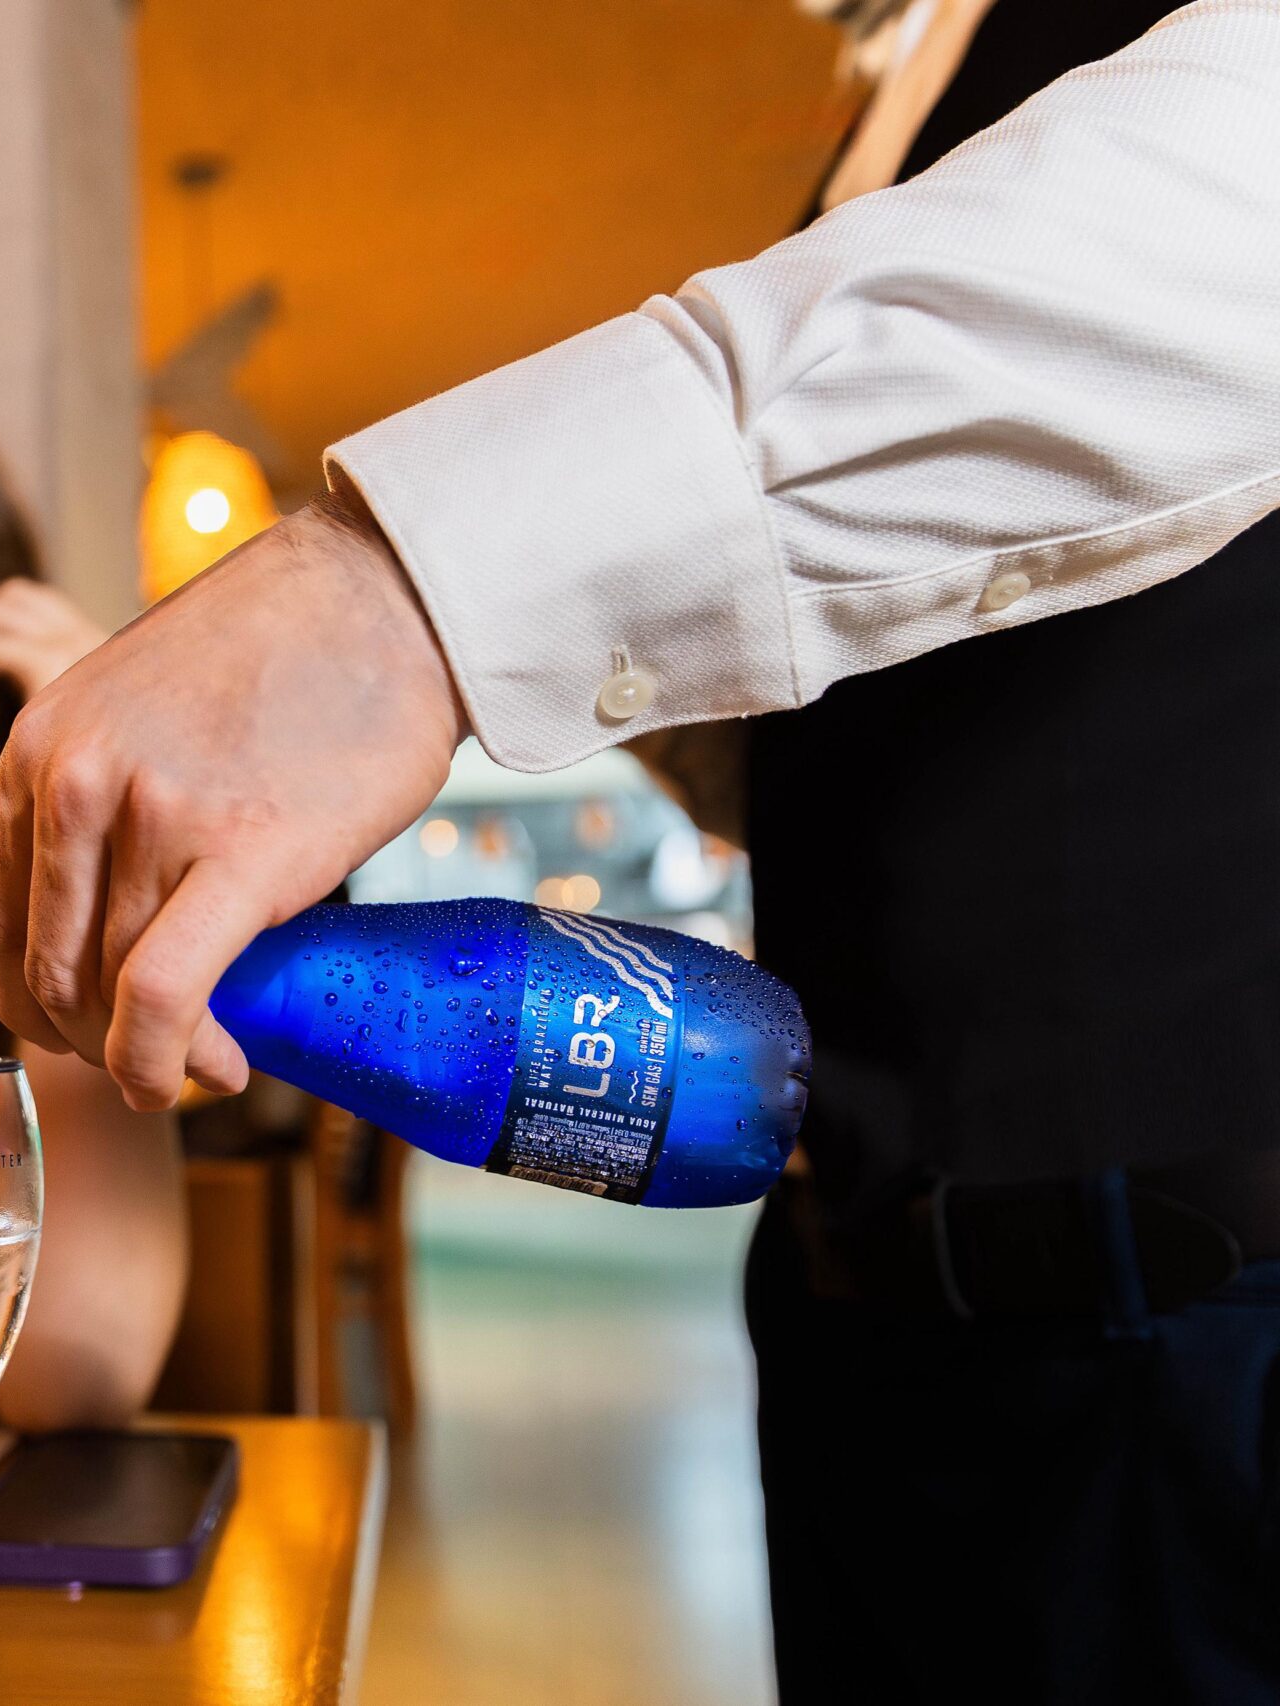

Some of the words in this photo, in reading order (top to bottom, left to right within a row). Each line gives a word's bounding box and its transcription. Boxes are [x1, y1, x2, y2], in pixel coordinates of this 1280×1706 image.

[563, 994, 620, 1097] LBR
[650, 1034, 666, 1056] 350
[527, 1061, 541, 1086] LIFE
[643, 1065, 663, 1084] GÁS
[525, 1097, 575, 1114] NATURAL
[641, 1089, 659, 1107] SEM
[579, 1107, 625, 1123] MINERAL
[629, 1117, 657, 1130] ÁGUA
